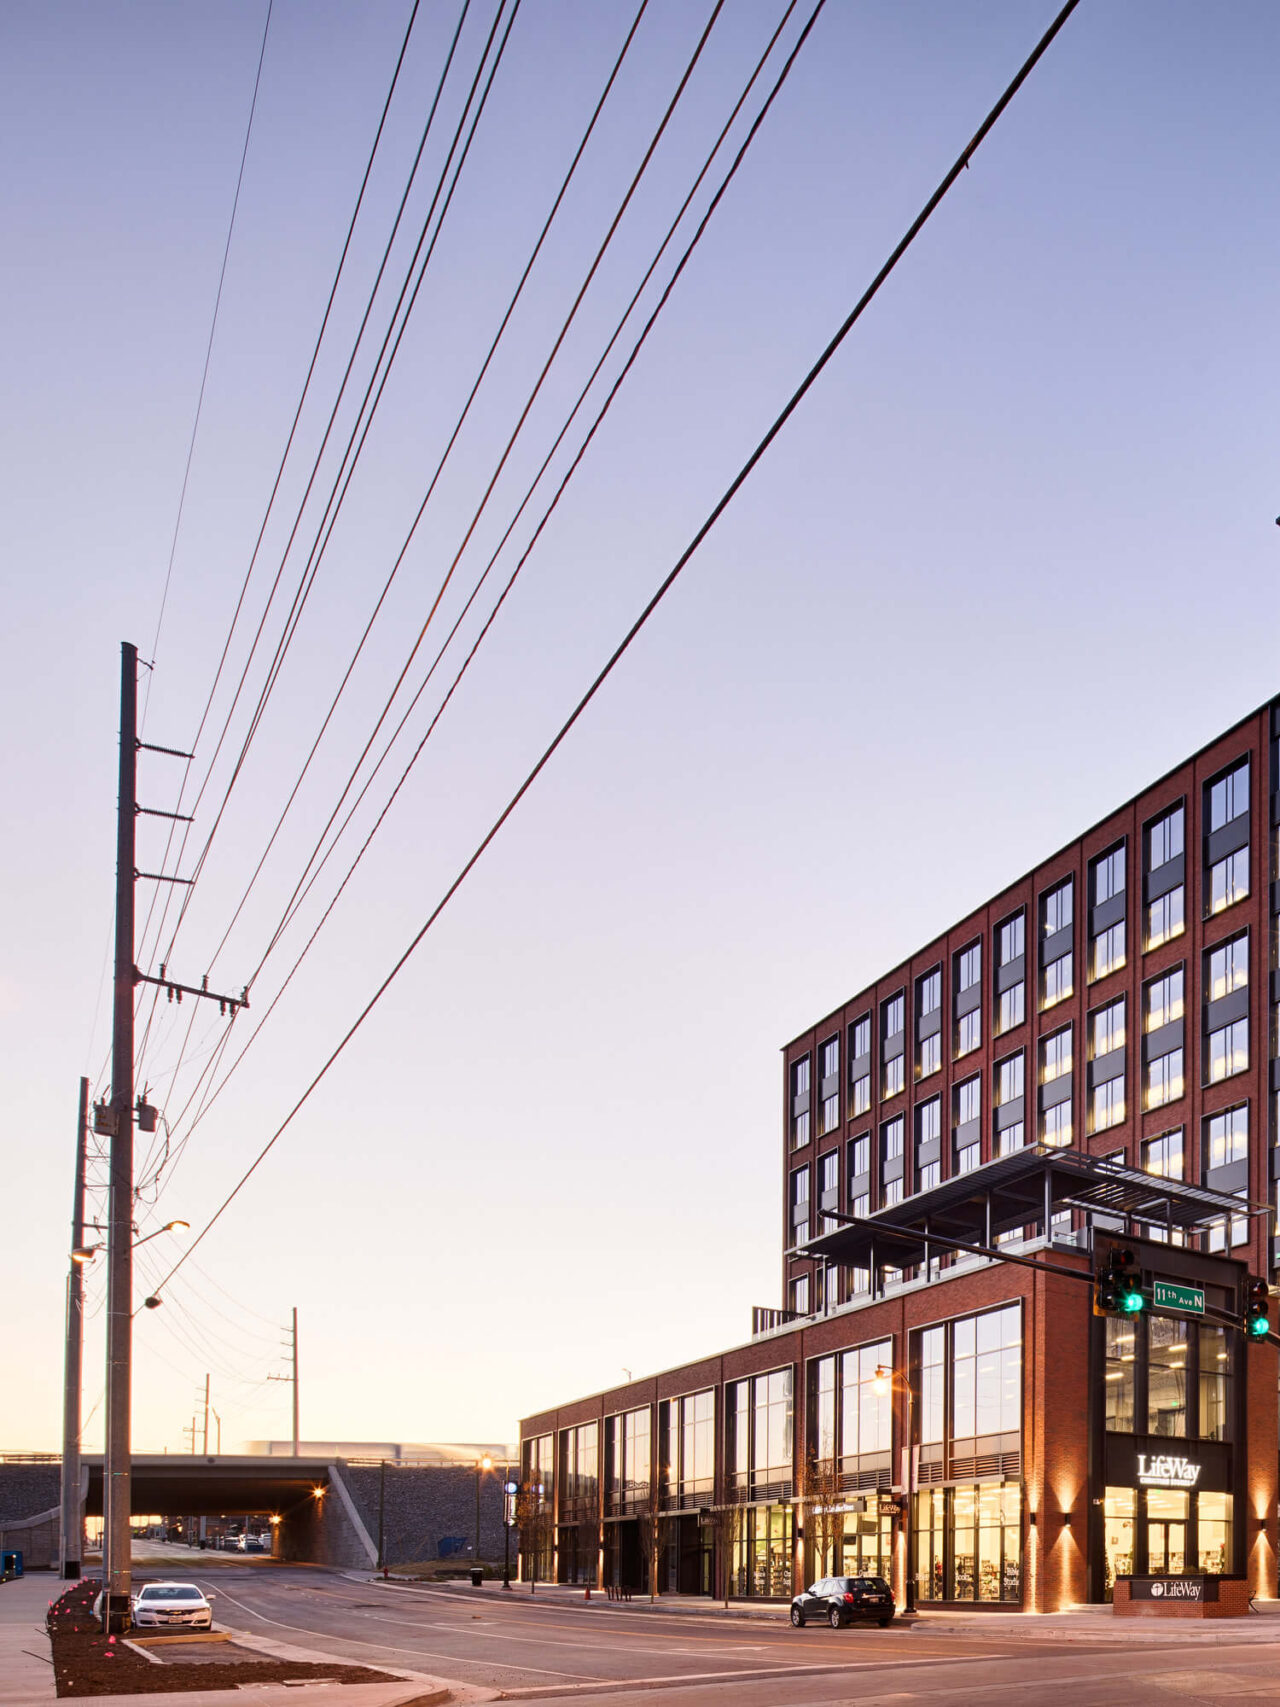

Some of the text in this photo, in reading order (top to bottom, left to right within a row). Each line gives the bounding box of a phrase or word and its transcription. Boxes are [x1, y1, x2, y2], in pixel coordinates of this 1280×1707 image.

[1157, 1288, 1203, 1308] 11th Ave N
[1137, 1454, 1201, 1485] LifeWay
[1163, 1581, 1201, 1600] LifeWay
